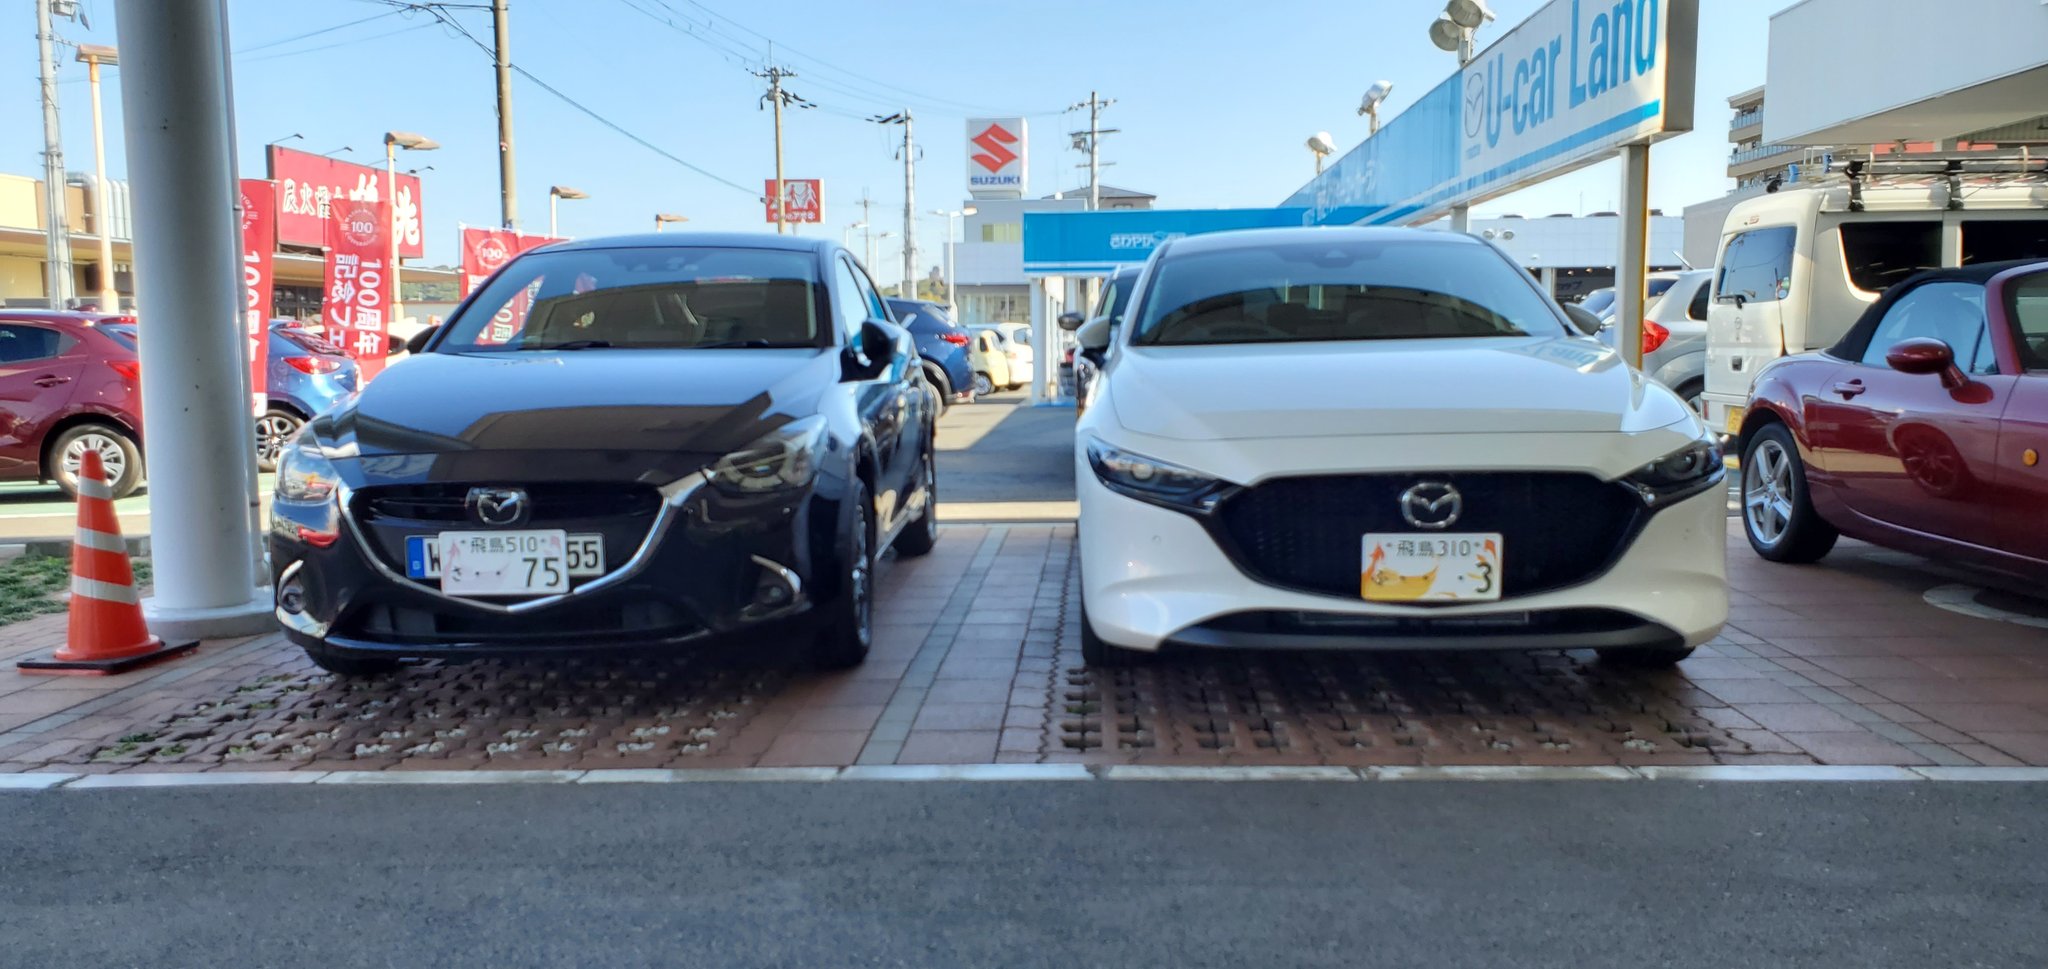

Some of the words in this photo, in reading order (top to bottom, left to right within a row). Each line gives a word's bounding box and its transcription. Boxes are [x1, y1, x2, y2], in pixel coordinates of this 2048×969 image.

[1486, 34, 1561, 148] U-car
[1569, 0, 1658, 109] Land
[970, 175, 1021, 185] SUZUKI
[351, 221, 373, 233] 100
[482, 247, 503, 258] 100
[353, 258, 382, 355] 100周年
[522, 557, 560, 588] 75
[1475, 562, 1493, 593] 3
